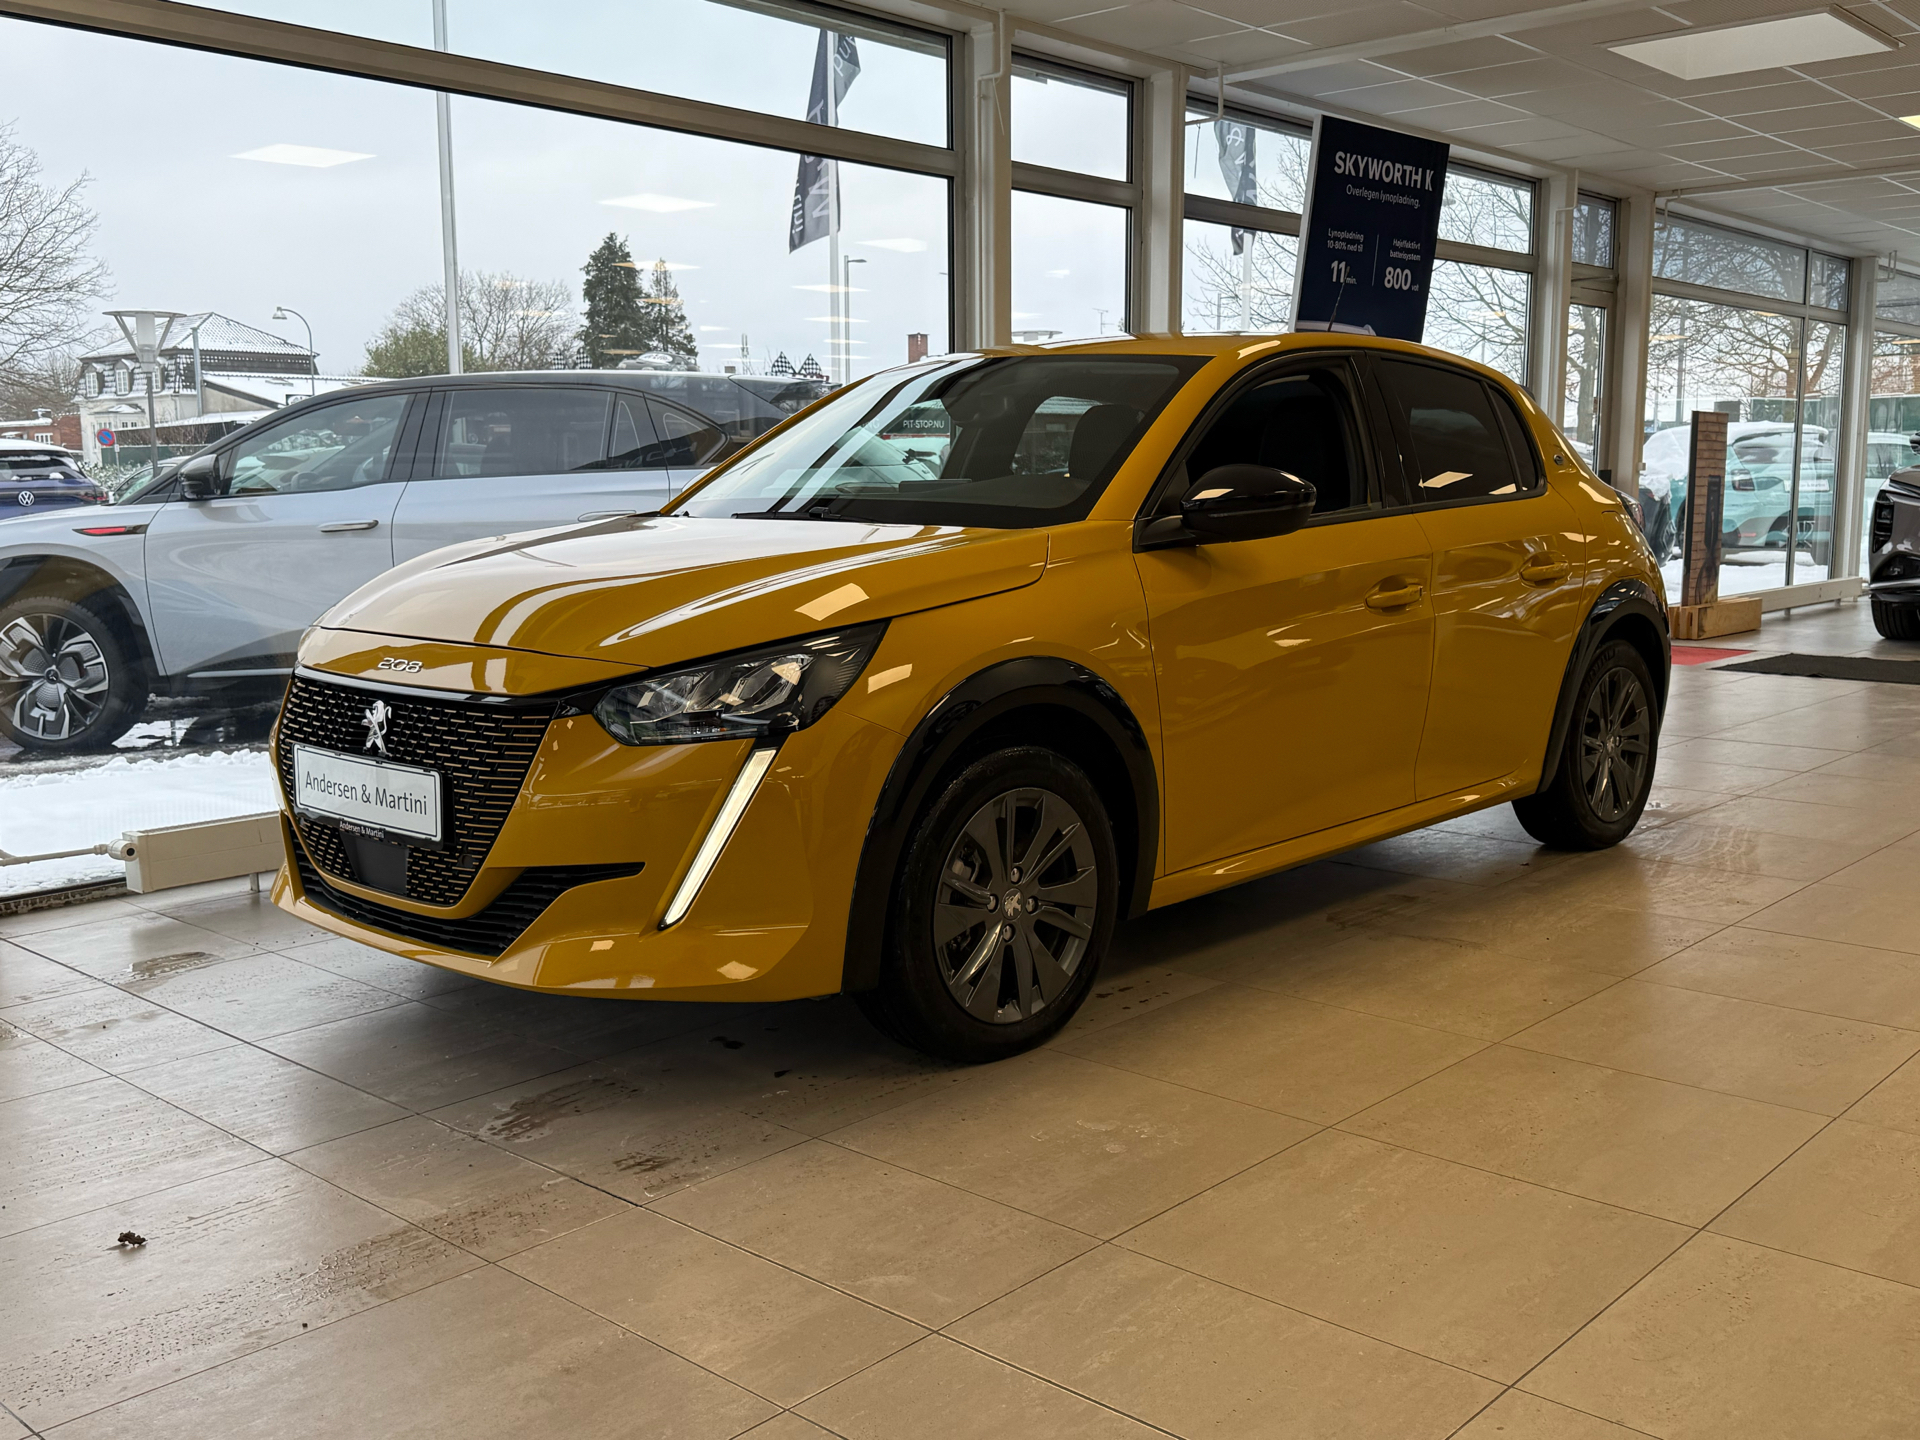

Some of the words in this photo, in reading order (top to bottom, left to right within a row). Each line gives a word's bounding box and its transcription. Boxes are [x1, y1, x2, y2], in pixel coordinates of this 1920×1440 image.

[1334, 151, 1422, 189] SKYWORTH
[1425, 169, 1434, 191] K
[1346, 184, 1380, 201] Overlegen
[1380, 190, 1421, 209] lynopladning.
[1327, 240, 1347, 250] 10-80%
[1328, 228, 1364, 242] Lynopladning
[1331, 260, 1346, 283] 11
[1384, 266, 1412, 291] 800
[377, 657, 423, 674] 208
[305, 771, 358, 802] Andersen
[361, 784, 371, 805] &
[375, 787, 427, 816] Martini
[340, 820, 361, 833] Andersen
[365, 827, 385, 839] Martini
